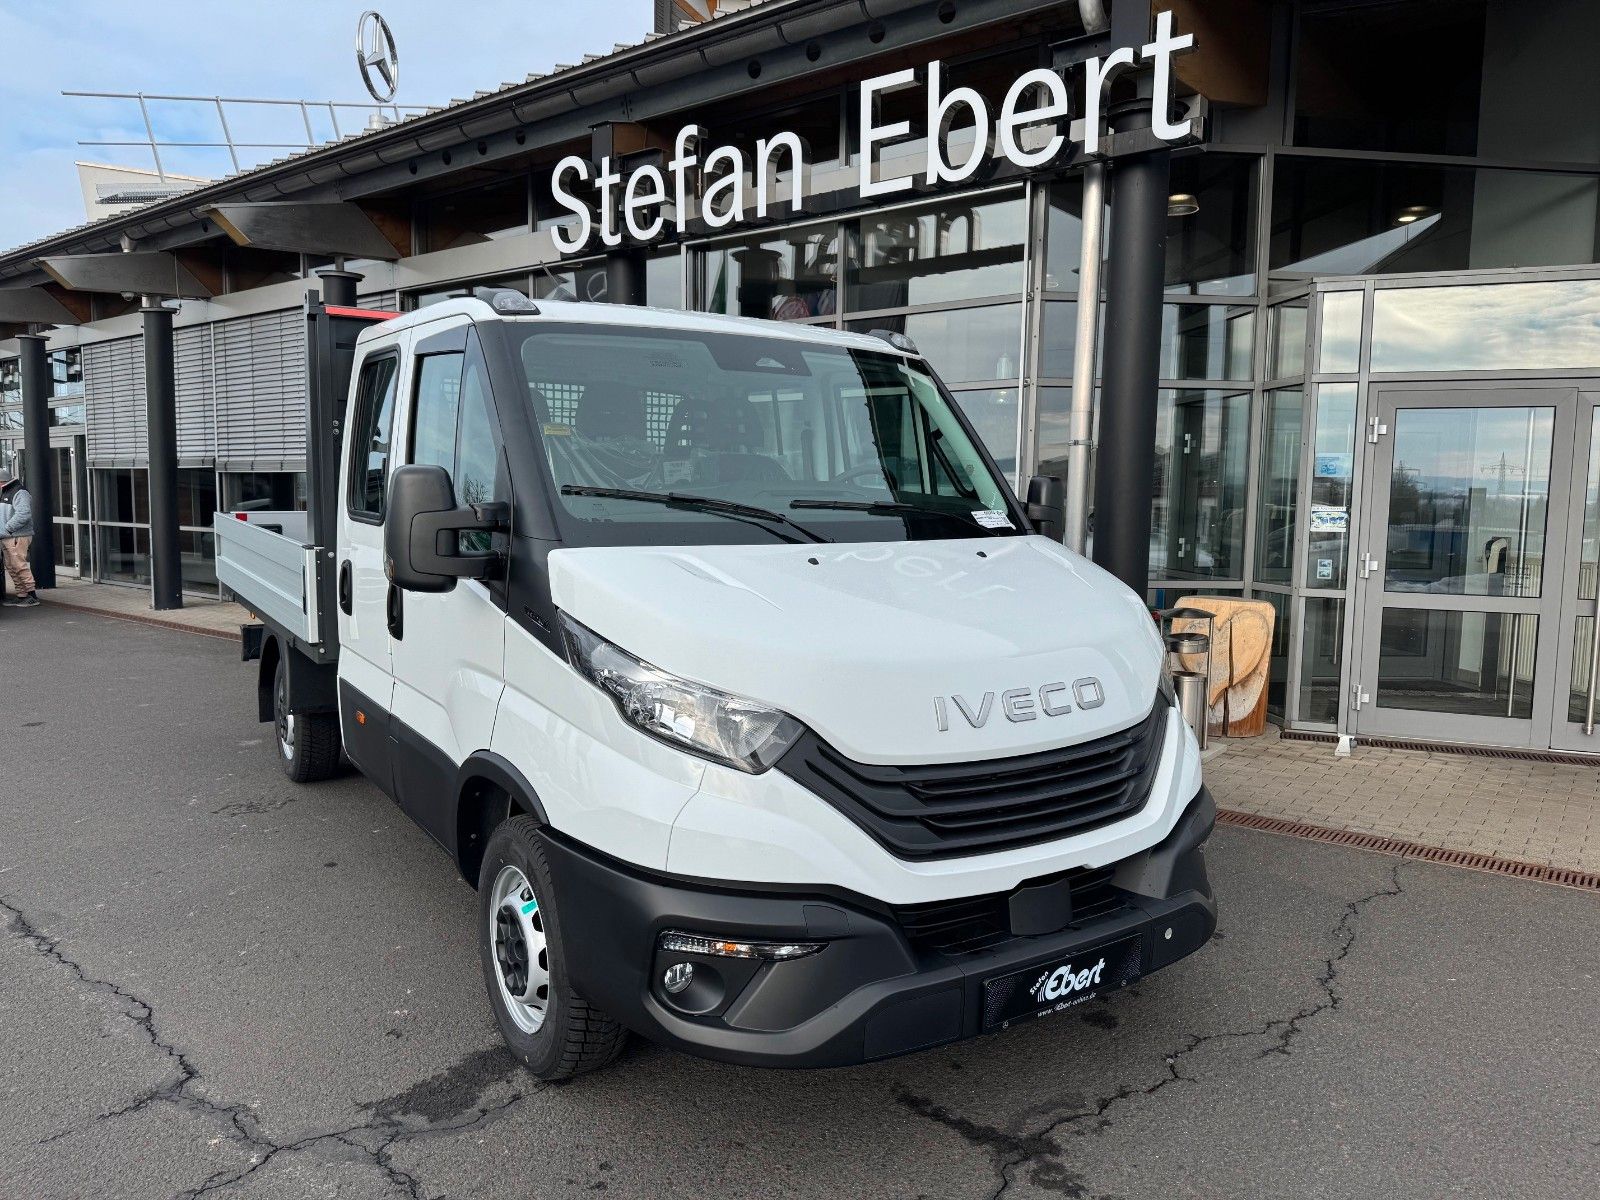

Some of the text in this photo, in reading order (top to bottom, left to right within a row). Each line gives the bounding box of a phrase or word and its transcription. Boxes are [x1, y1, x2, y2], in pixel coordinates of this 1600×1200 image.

[549, 10, 1194, 255] Stefan Ebert
[934, 676, 1106, 732] IVECO
[1029, 971, 1049, 996] Stefan
[1045, 957, 1106, 1000] Ebert
